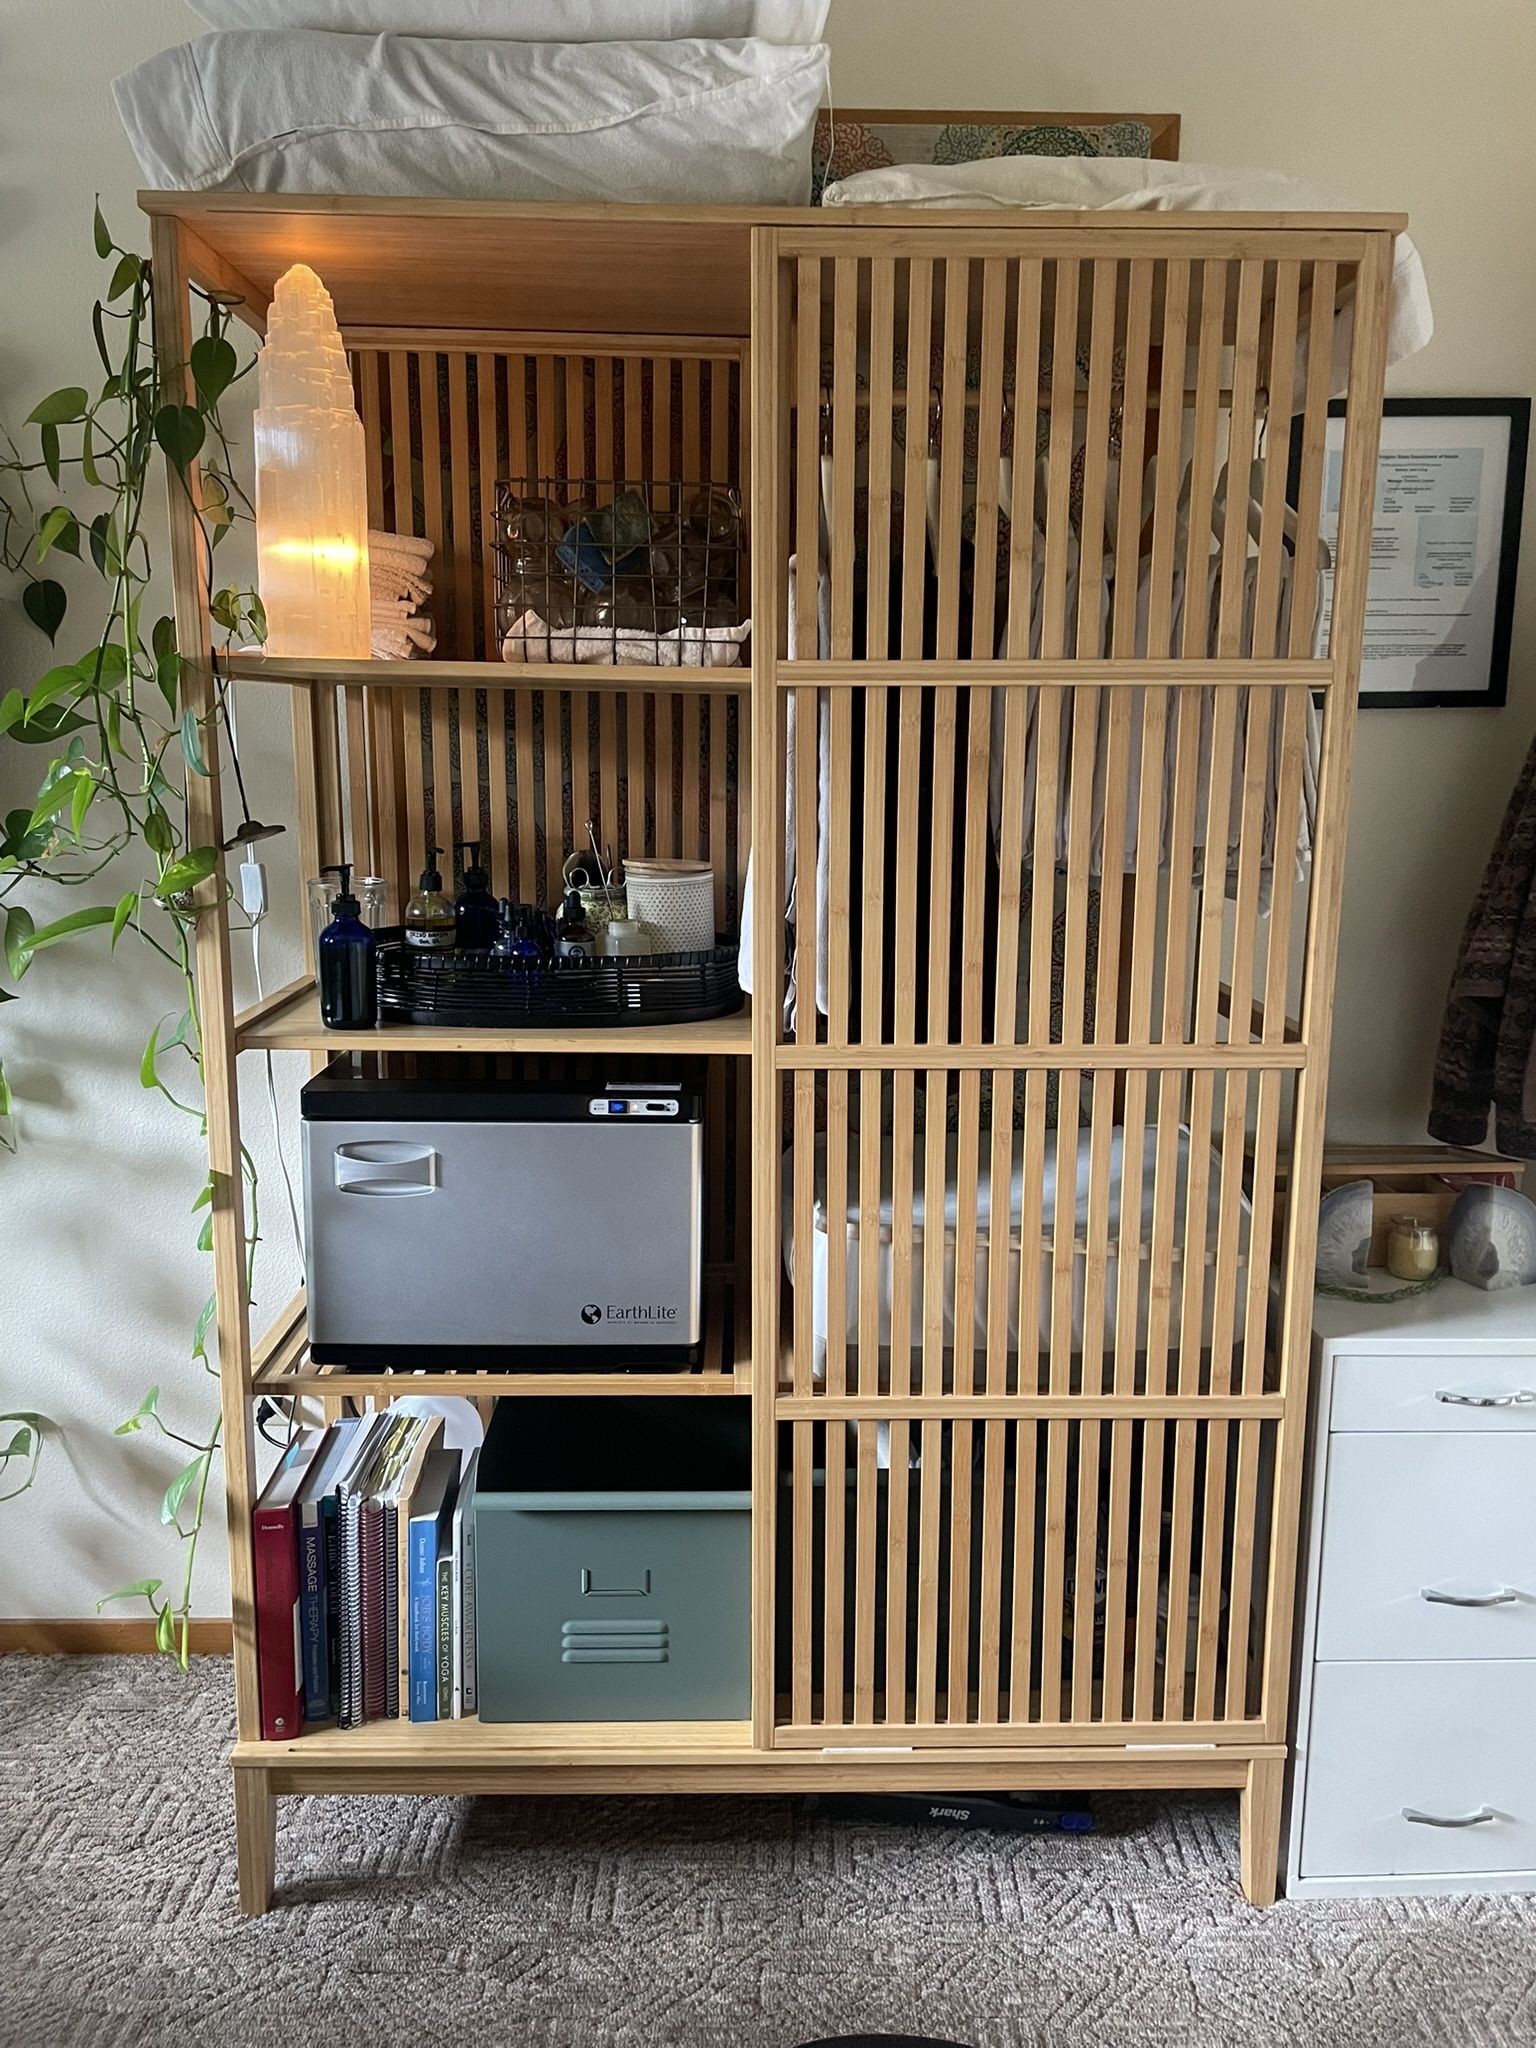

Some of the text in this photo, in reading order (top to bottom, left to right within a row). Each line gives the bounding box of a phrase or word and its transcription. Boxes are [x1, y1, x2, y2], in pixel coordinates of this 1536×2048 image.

[606, 1305, 677, 1319] EarthLite
[306, 1536, 320, 1643] MASSAGE THERAPY
[440, 1585, 450, 1601] KEY
[440, 1603, 450, 1642] MUSCLES
[464, 1568, 474, 1663] CORE AWARENESS
[421, 1625, 433, 1655] BODY
[440, 1656, 450, 1683] YOGA
[928, 1806, 971, 1820] Shark
